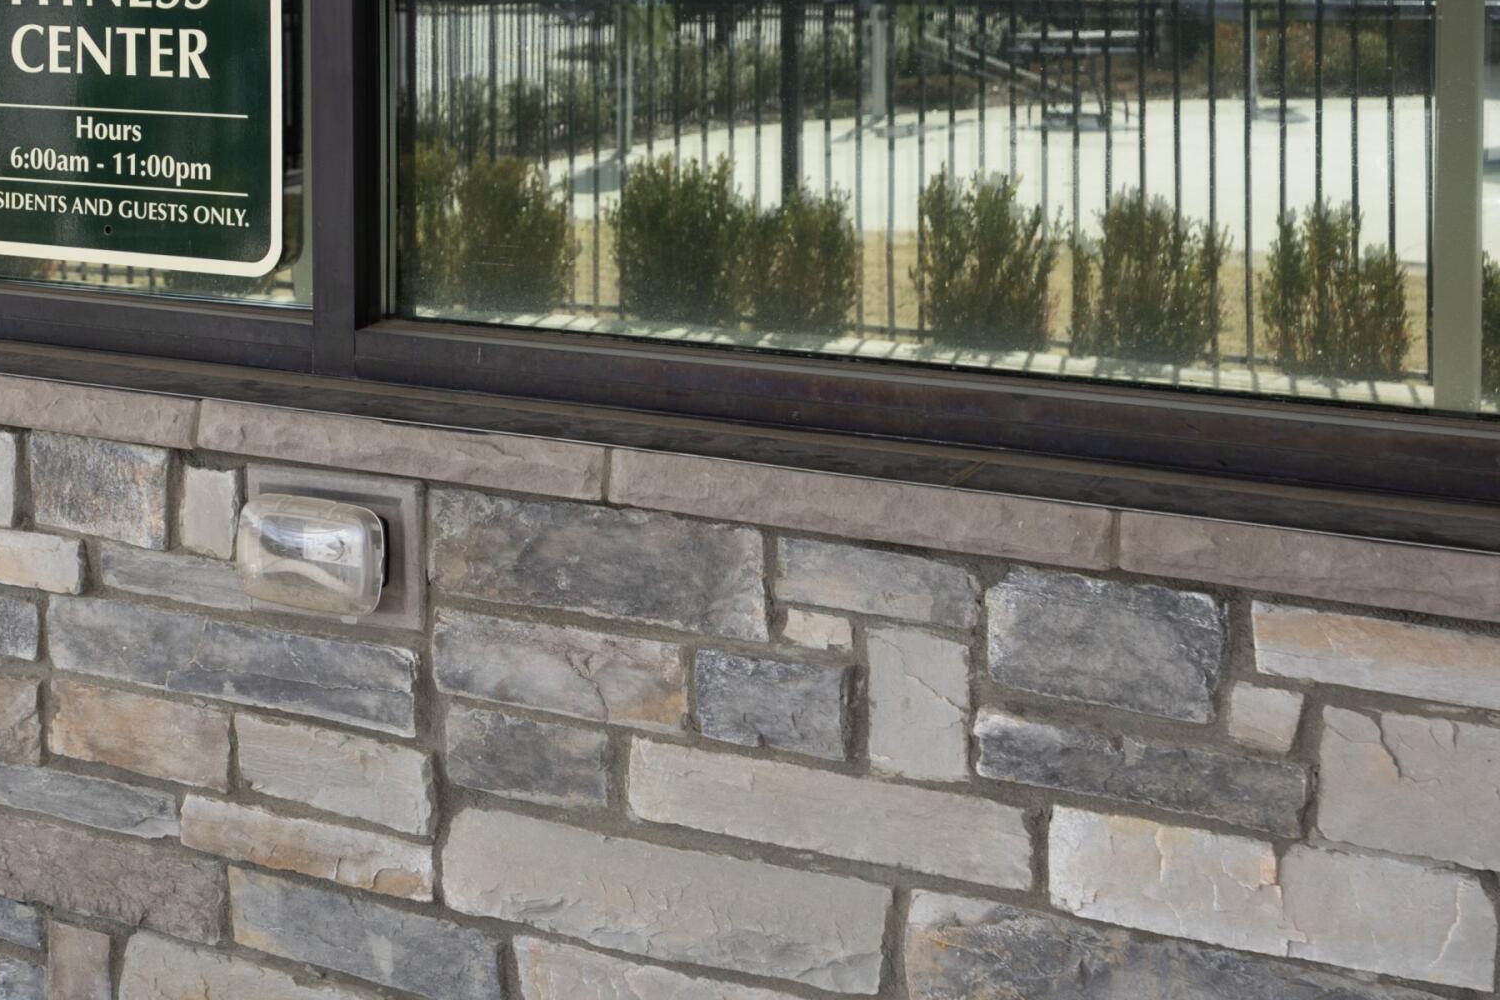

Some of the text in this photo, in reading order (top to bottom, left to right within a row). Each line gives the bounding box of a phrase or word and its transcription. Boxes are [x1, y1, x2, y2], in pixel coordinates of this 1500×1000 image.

[11, 23, 211, 79] CENTER
[75, 115, 142, 142] Hours
[10, 146, 89, 173] 6:00am
[112, 152, 212, 186] 11:00pm
[71, 197, 113, 218] AND
[118, 200, 188, 223] GUESTS
[193, 205, 250, 228] ONLY.
